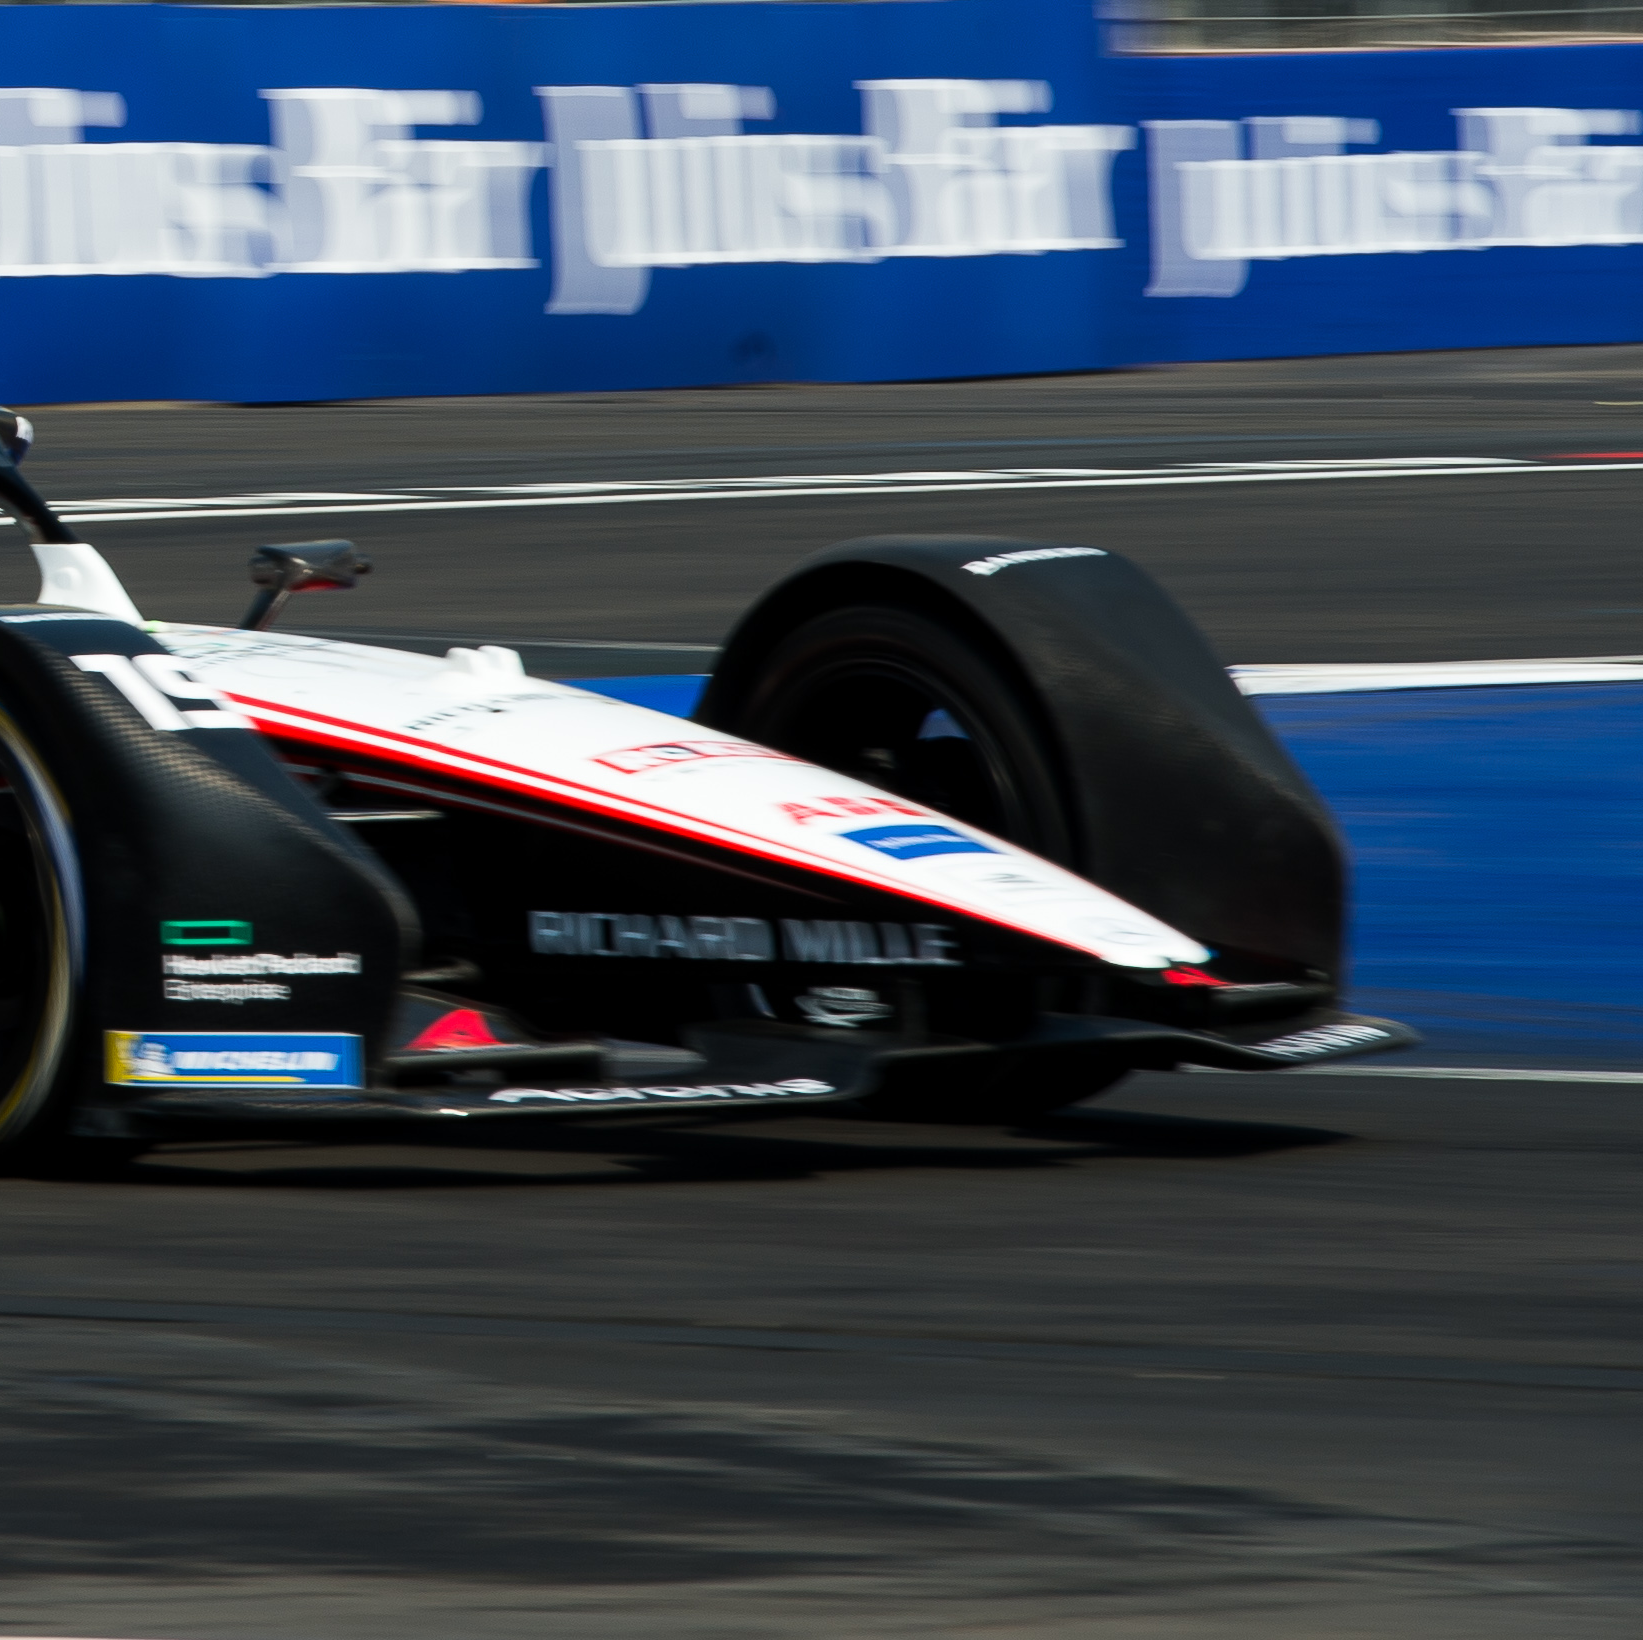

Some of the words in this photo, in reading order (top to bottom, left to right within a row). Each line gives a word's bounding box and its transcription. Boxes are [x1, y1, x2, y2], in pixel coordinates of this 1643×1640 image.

[259, 87, 545, 274] Bär
[533, 83, 898, 316] Julius
[853, 78, 1138, 260] Bär
[1143, 116, 1494, 298] Julius
[528, 910, 775, 961] RICHARD
[782, 917, 964, 966] MILLE
